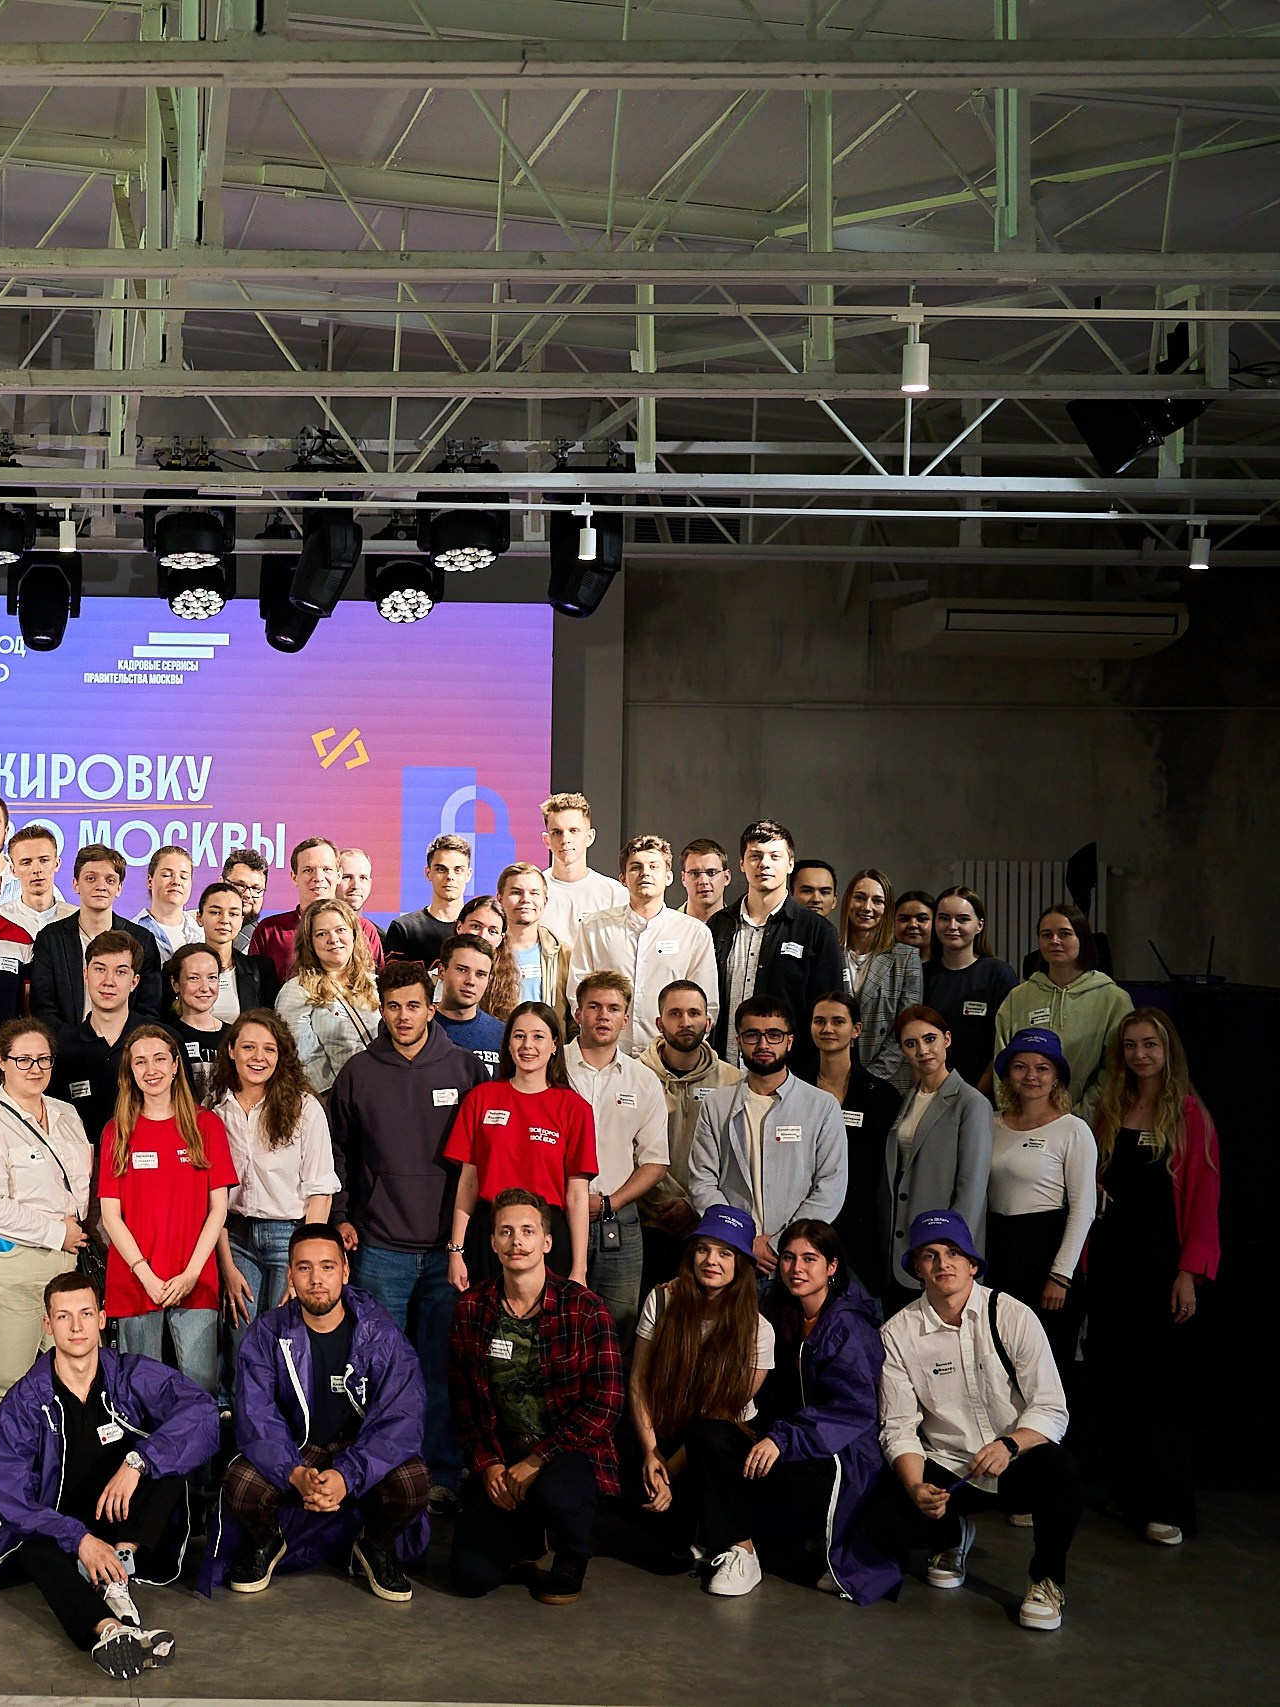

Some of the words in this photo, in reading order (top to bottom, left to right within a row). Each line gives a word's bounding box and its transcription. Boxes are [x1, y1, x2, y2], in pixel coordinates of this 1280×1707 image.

[117, 660, 161, 671] КАДРОВЫЕ
[162, 661, 199, 672] СЕРВИСЫ
[84, 672, 148, 684] ПРАВИТЕЛЬСТВА
[148, 674, 184, 685] МОСКВЫ
